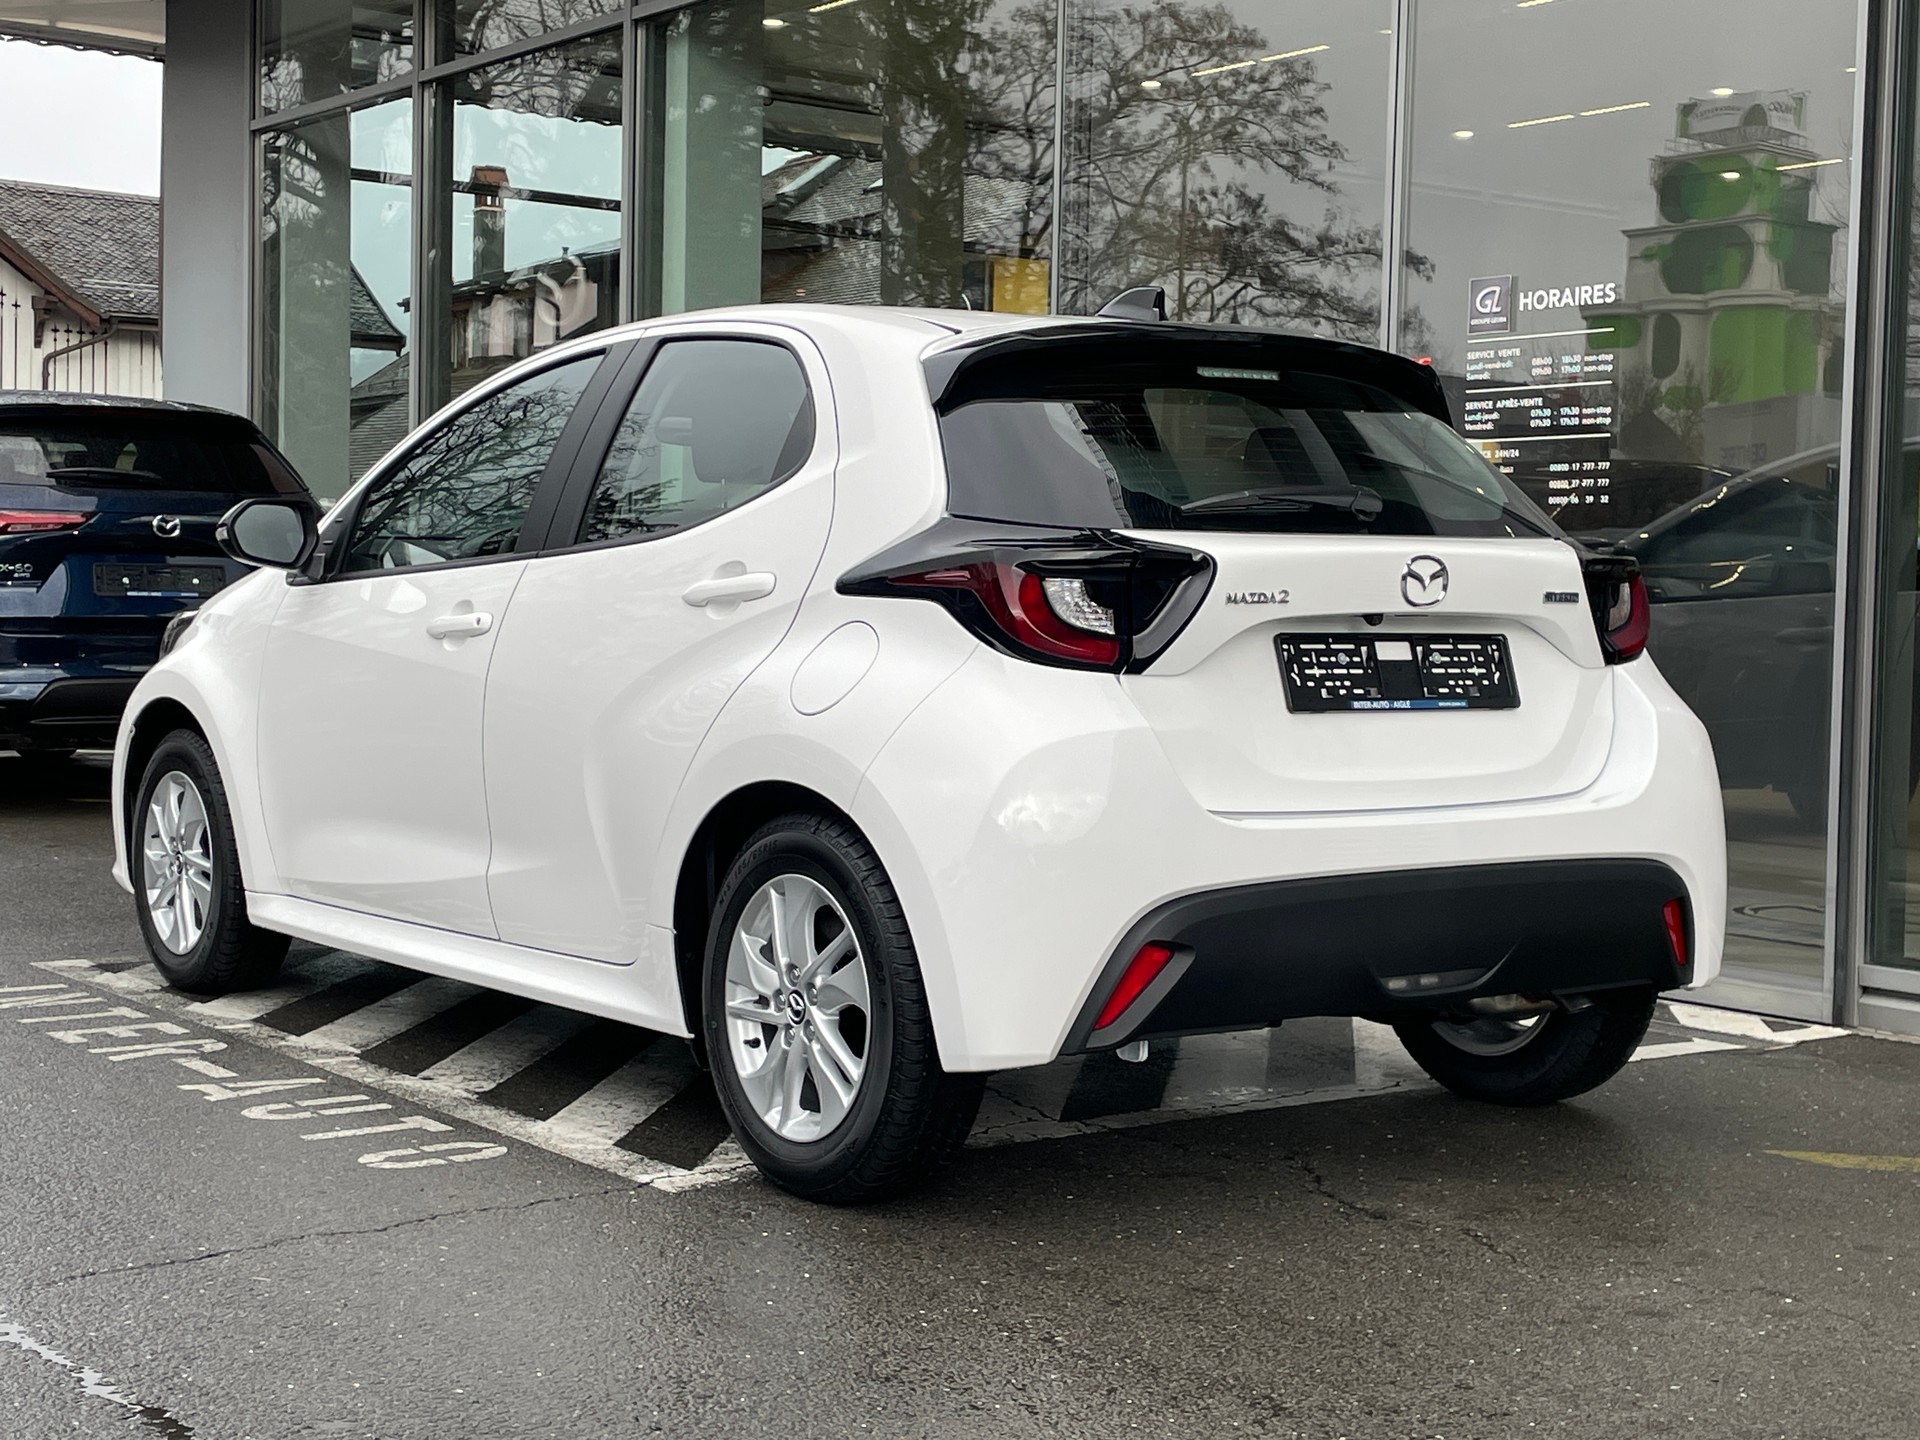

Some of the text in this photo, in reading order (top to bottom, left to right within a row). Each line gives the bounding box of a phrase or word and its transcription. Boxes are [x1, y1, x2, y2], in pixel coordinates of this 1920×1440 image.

[1475, 285, 1502, 314] GL
[1519, 282, 1616, 312] HORAIRES
[1466, 348, 1521, 360] SERVICE VENTE
[1584, 353, 1614, 362] non-stop
[1531, 366, 1553, 376] 09h00
[1561, 364, 1581, 374] 17h00
[1583, 363, 1614, 372] non-stop
[1465, 397, 1543, 411] SERVICE APRÈS-VENTE
[1530, 407, 1552, 417] 07h30
[1560, 406, 1580, 415] 17h30
[1582, 406, 1612, 415] non-stop
[1530, 418, 1552, 428] 07h30
[1560, 416, 1580, 426] 17h30
[1581, 417, 1612, 425] non-stop
[1494, 449, 1520, 459] 24H/24
[1571, 462, 1580, 471] 17
[1582, 461, 1595, 471] 777
[1597, 461, 1611, 470] 777
[1581, 478, 1595, 487] 777
[1597, 478, 1610, 487] 777
[0, 563, 33, 572] X-60
[1393, 700, 1411, 709] AIGLE
